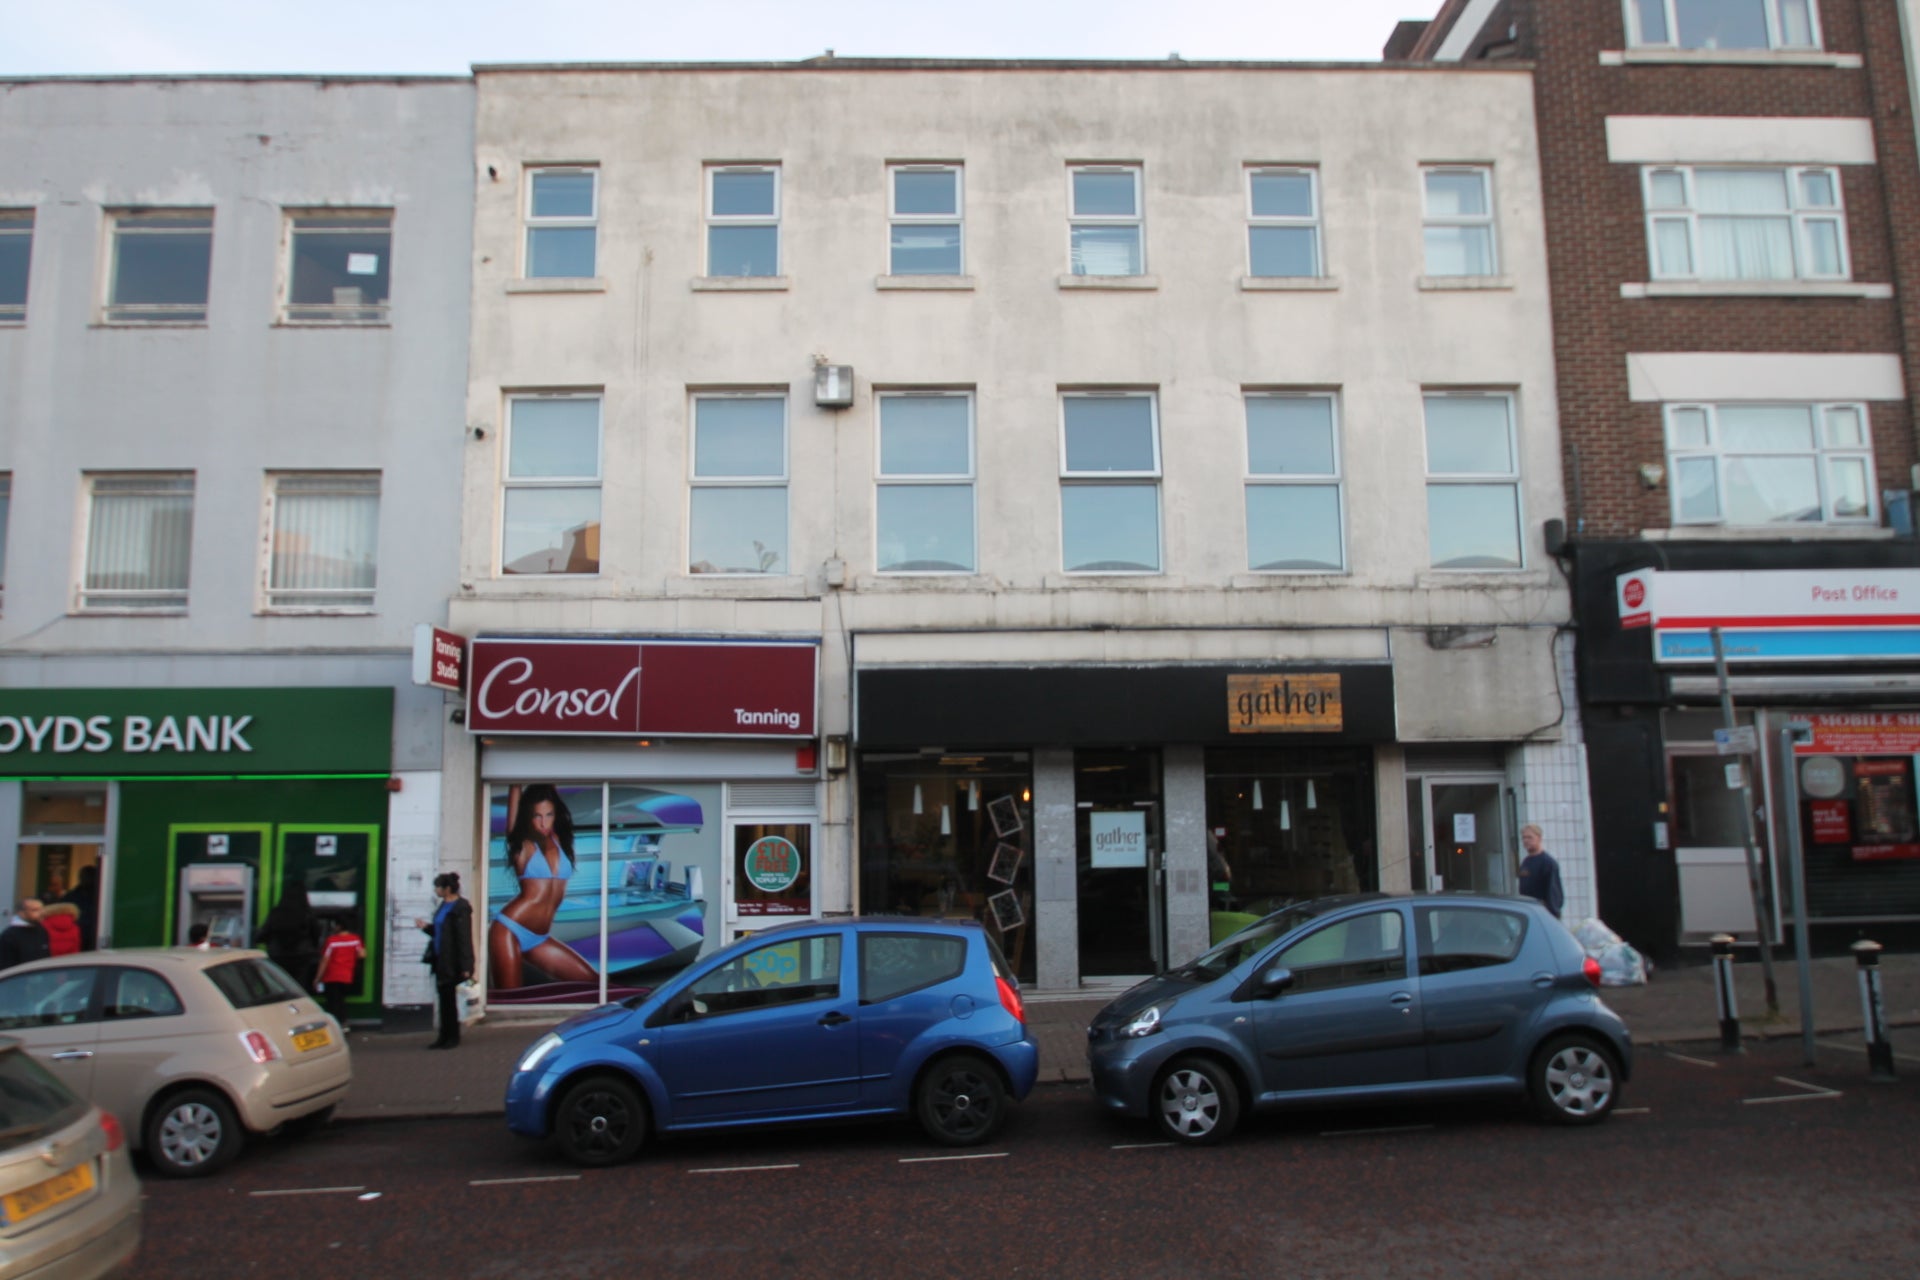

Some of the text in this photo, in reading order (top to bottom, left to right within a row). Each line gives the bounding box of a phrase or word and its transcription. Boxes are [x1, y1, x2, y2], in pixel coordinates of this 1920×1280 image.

[1811, 584, 1898, 601] Post Office
[436, 637, 461, 663] Tanning
[437, 660, 459, 681] Studio
[478, 656, 642, 720] Consol
[1238, 680, 1333, 726] gather
[734, 708, 800, 729] Tanning
[1820, 713, 1893, 726] MOBILE
[123, 715, 253, 752] BANK
[1096, 827, 1141, 850] gather
[757, 842, 789, 859] £10
[755, 859, 789, 873] FREE
[748, 951, 797, 979] 50p
